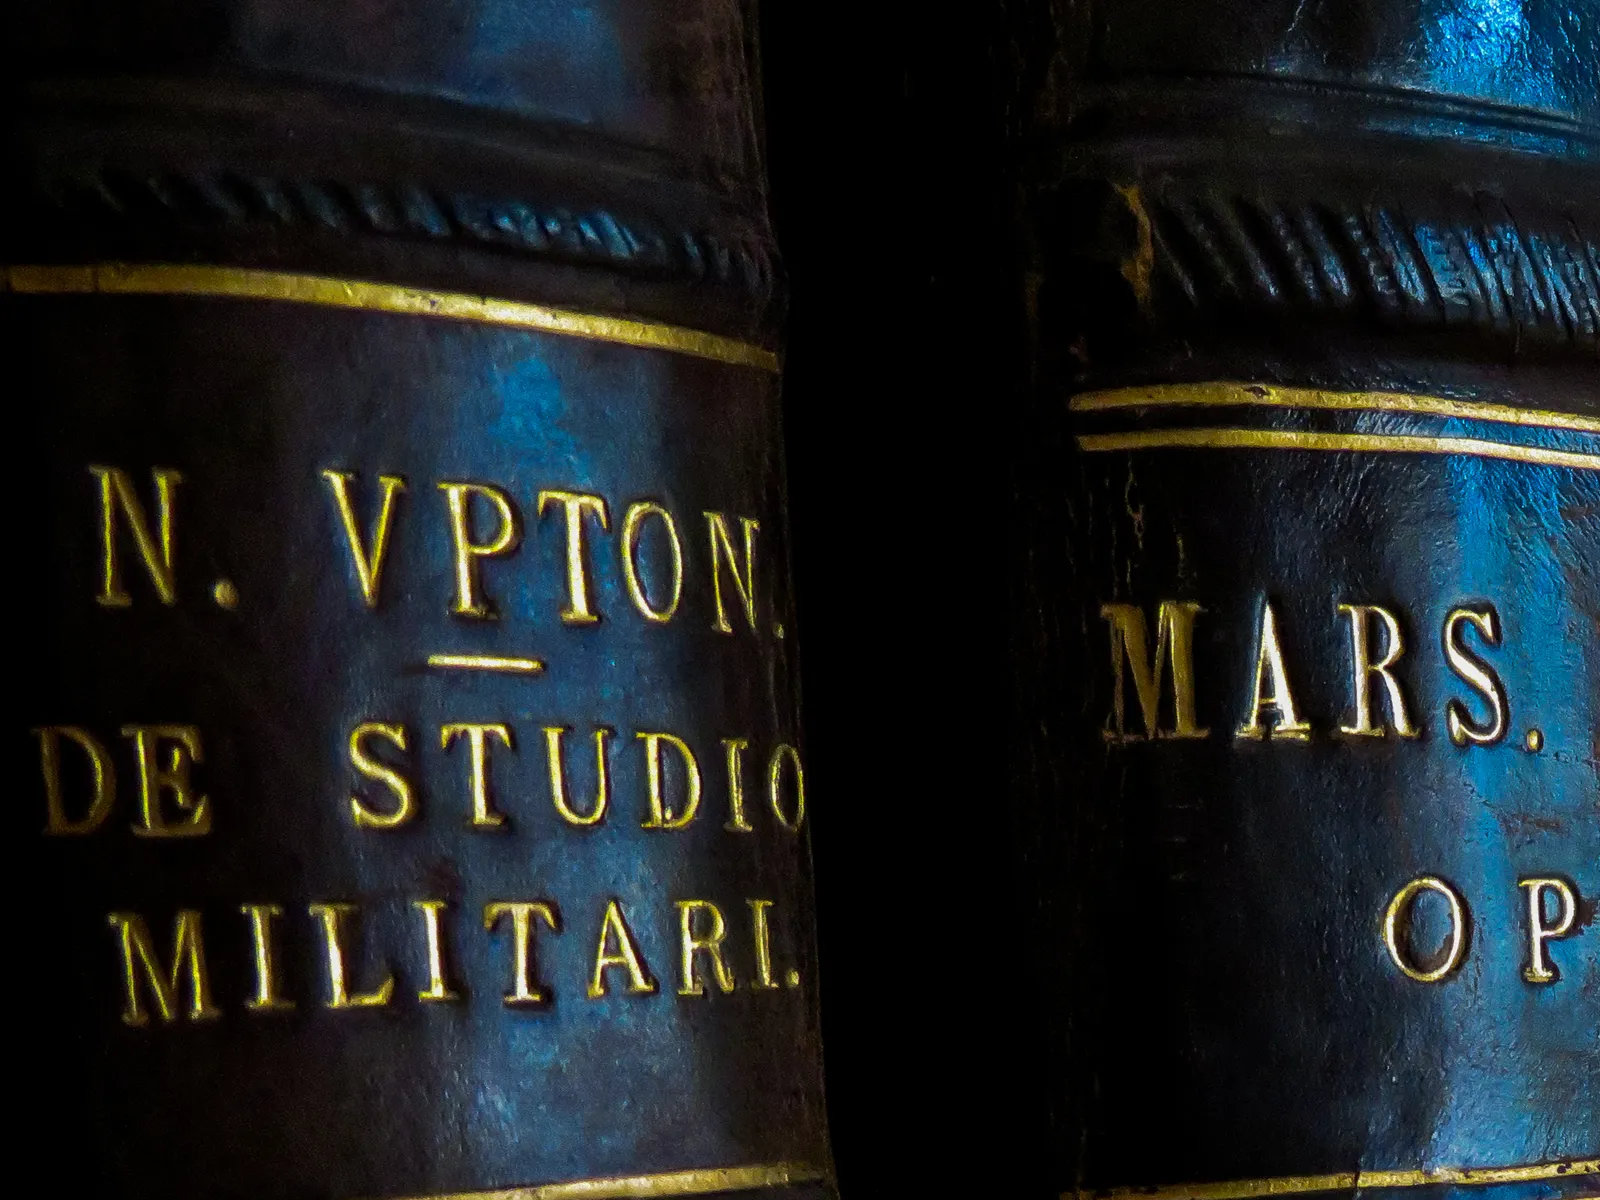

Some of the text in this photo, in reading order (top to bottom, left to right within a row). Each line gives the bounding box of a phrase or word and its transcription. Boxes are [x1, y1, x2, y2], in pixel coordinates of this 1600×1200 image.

[88, 464, 786, 639] N. VPTON.
[1098, 597, 1544, 752] MARS.
[31, 721, 805, 838] DE STUDIO
[108, 898, 801, 1028] MILITARI.
